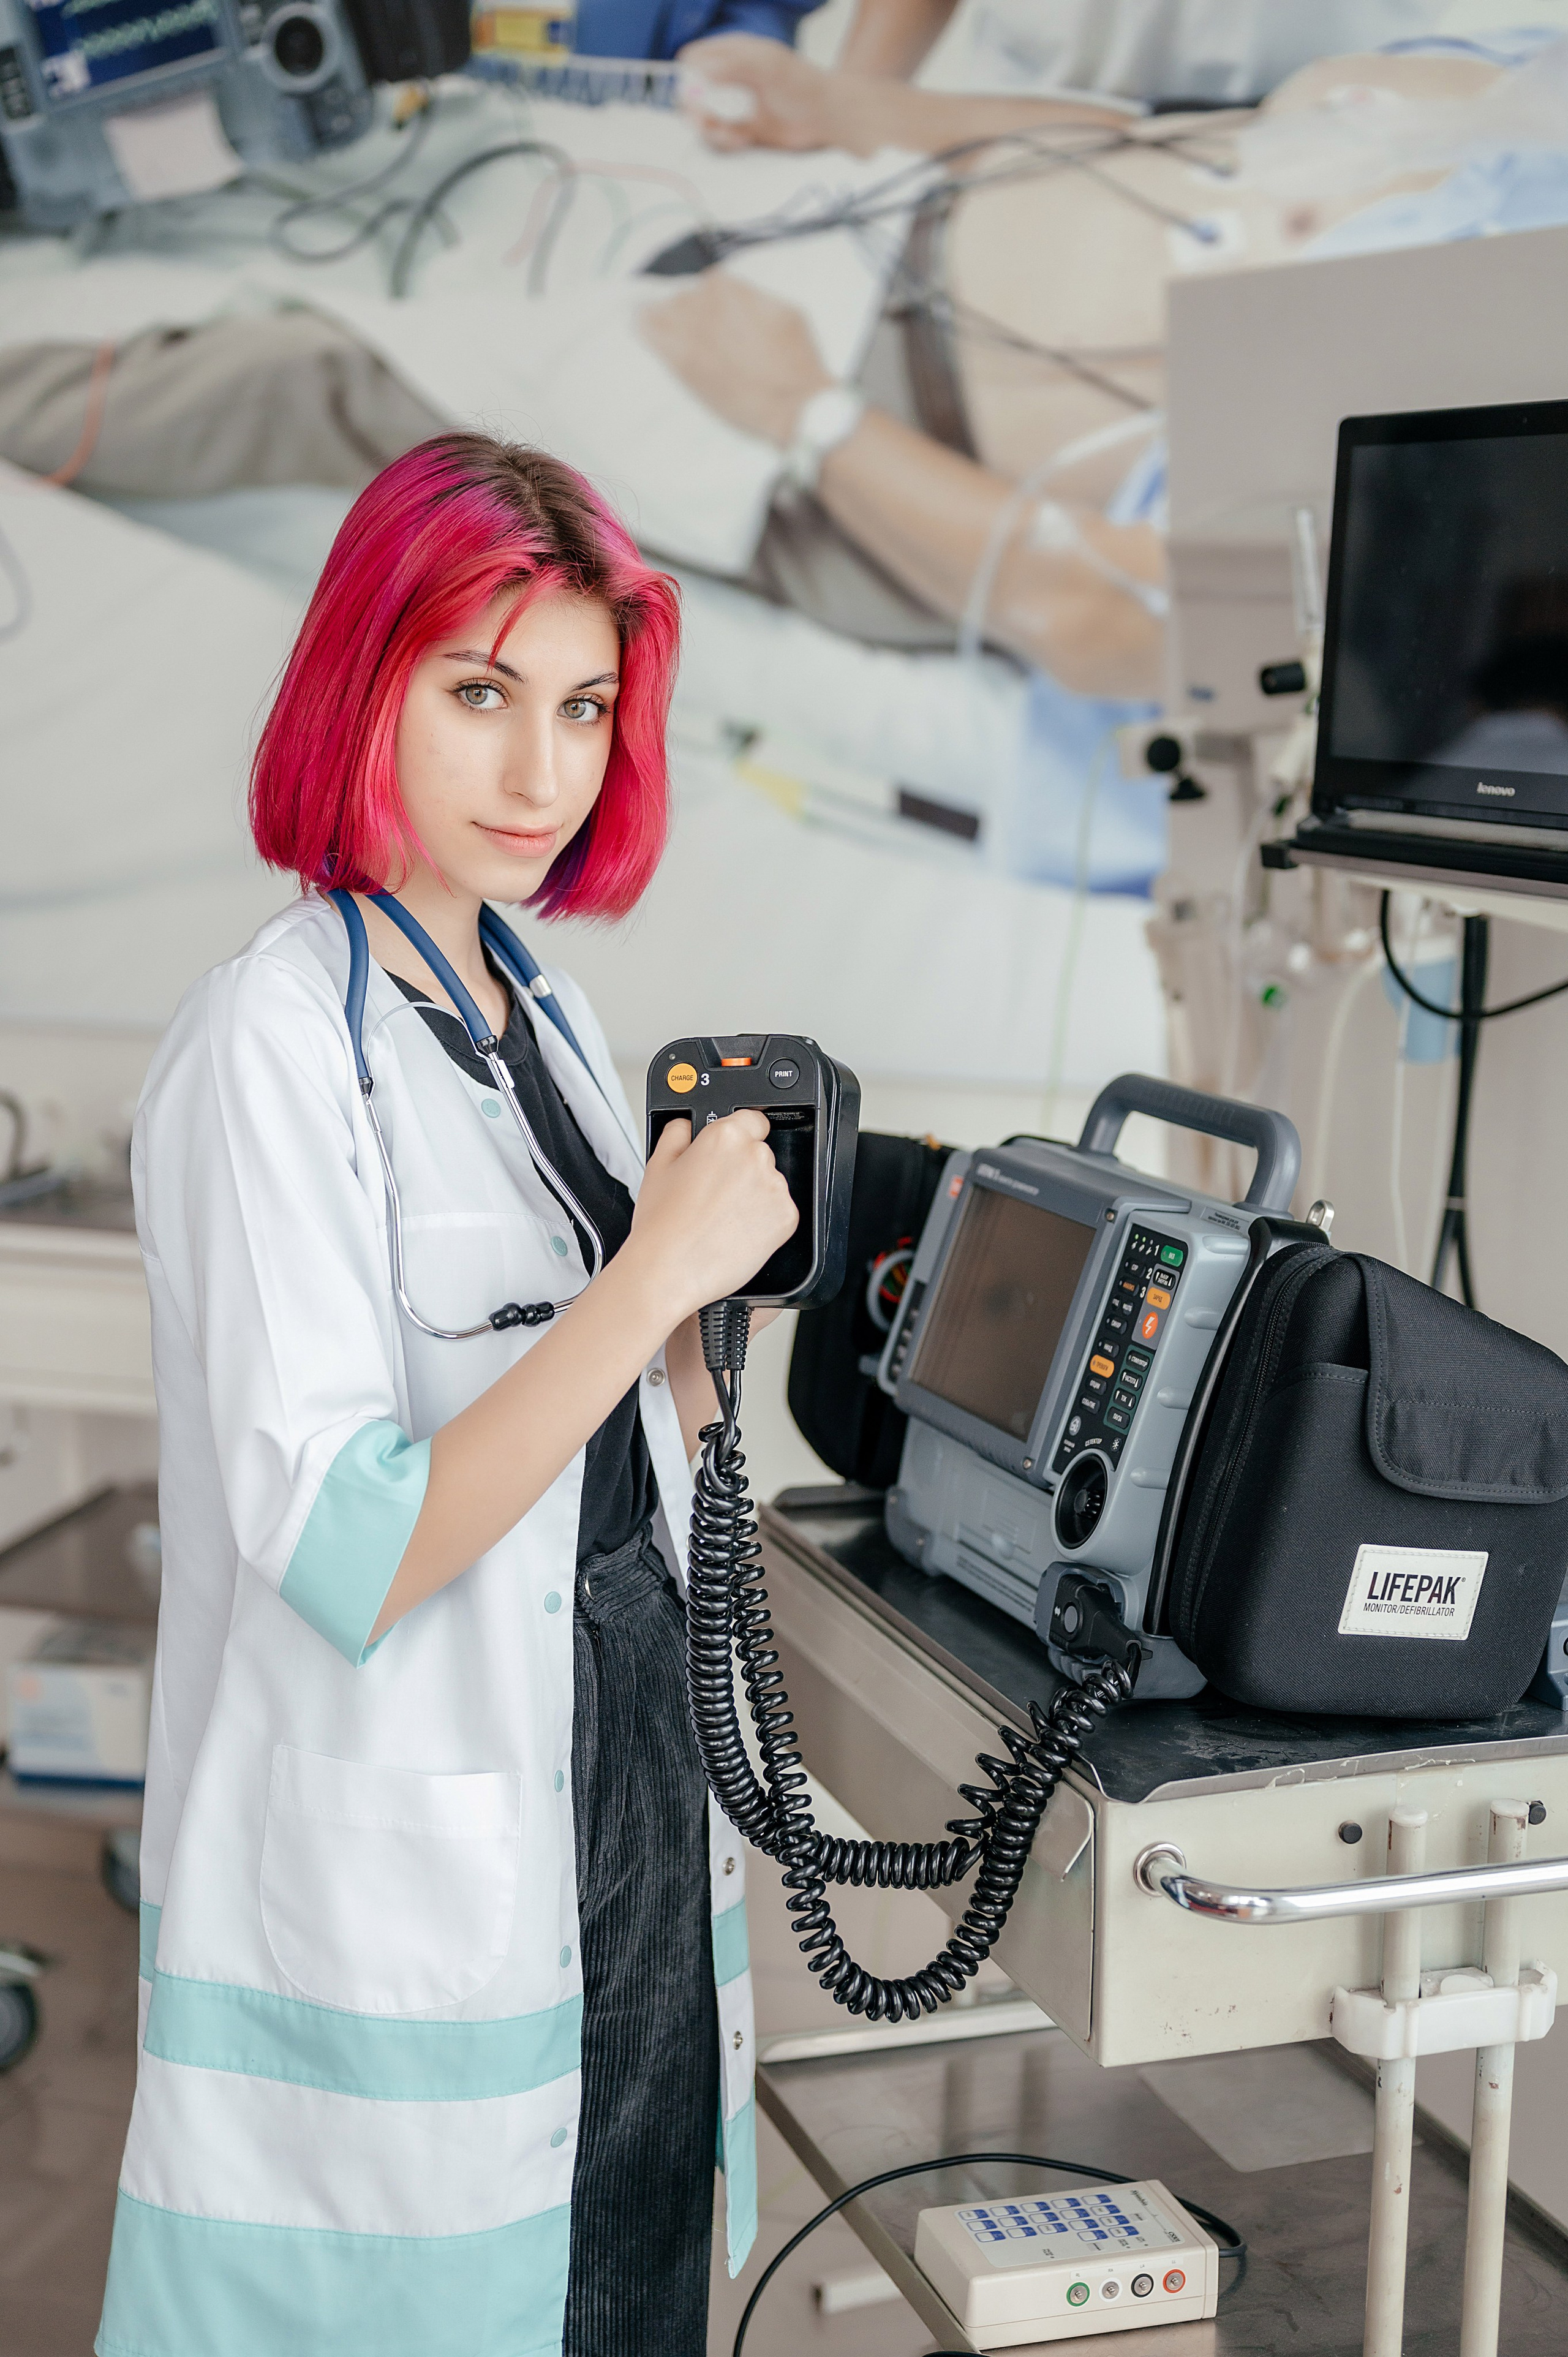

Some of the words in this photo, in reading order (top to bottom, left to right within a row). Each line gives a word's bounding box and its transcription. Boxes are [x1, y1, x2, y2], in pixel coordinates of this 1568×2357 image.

[1477, 782, 1516, 797] lenovo
[701, 1073, 710, 1086] 3
[1154, 1245, 1159, 1256] 1
[1145, 1267, 1153, 1280] 2
[1140, 1286, 1146, 1298] 3
[1085, 1438, 1102, 1447] СЕЛЕКТОР
[1363, 1602, 1455, 1616] MONITOR/DEFIBRILLATOR
